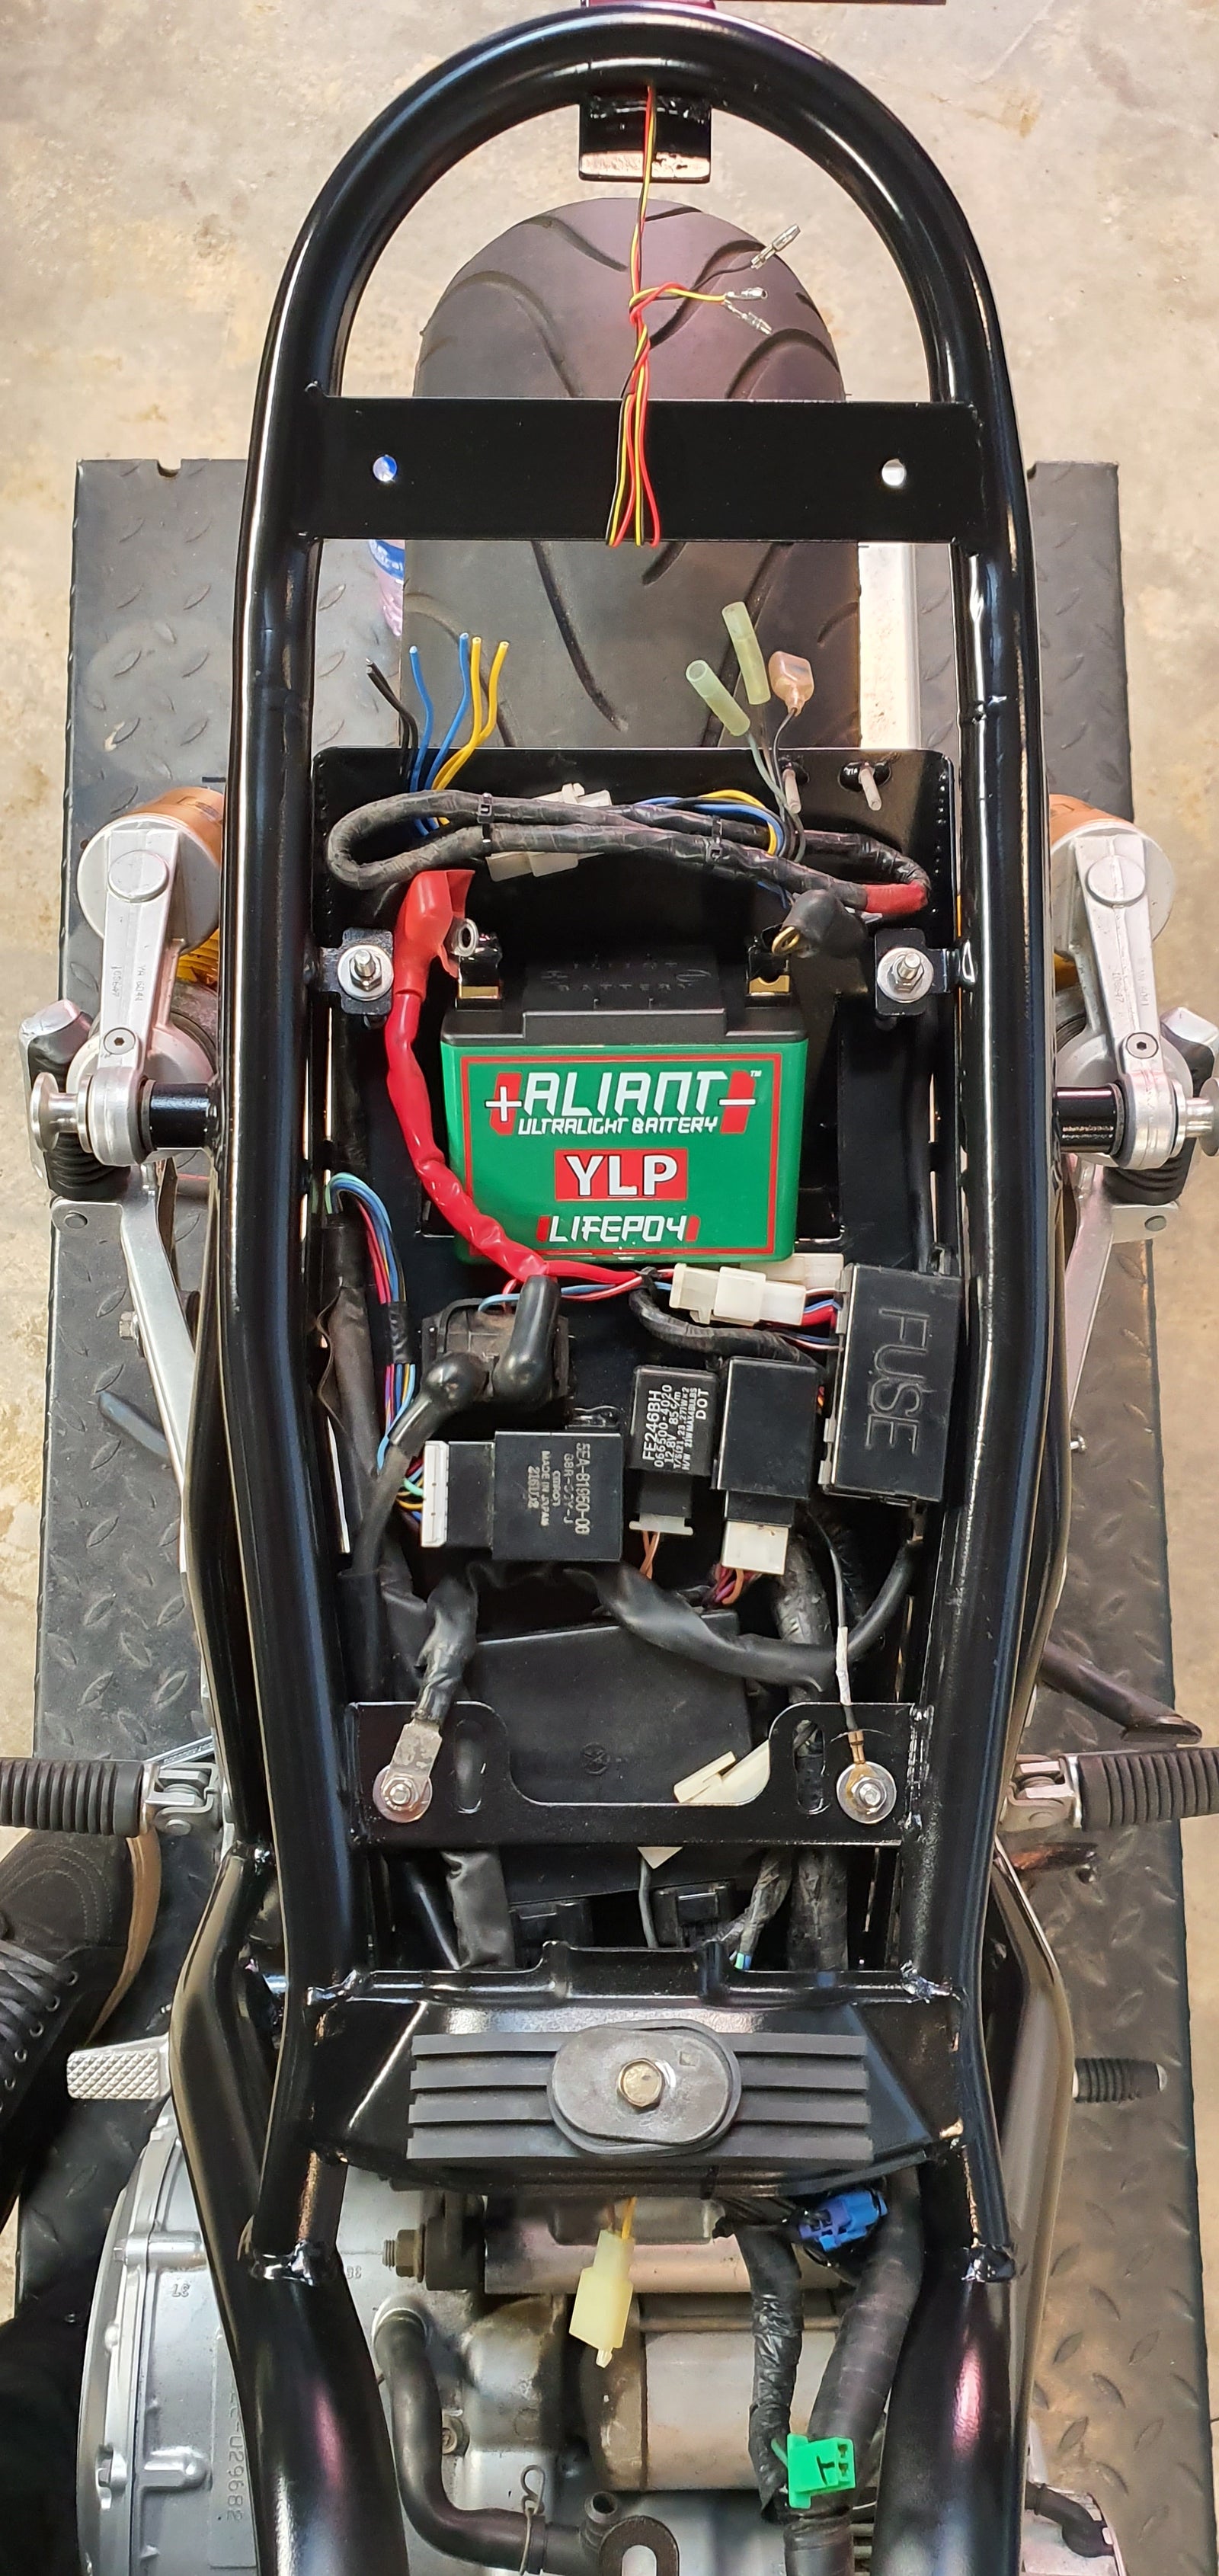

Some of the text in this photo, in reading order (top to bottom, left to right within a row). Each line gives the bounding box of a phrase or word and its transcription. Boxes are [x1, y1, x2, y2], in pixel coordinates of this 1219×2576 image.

[523, 1070, 728, 1117] ALIANT
[517, 1115, 718, 1135] ULTRALIGHT BATTERY
[565, 1154, 679, 1197] YLP
[549, 1214, 689, 1243] LIFEPO4
[865, 1308, 930, 1454] FUSE
[641, 1390, 662, 1461] FE246BH
[654, 1384, 673, 1468] 066500-4020
[696, 1387, 710, 1421] DOT
[664, 1435, 677, 1464] 12.8V
[540, 1450, 551, 1527] MADE IN JAPAN
